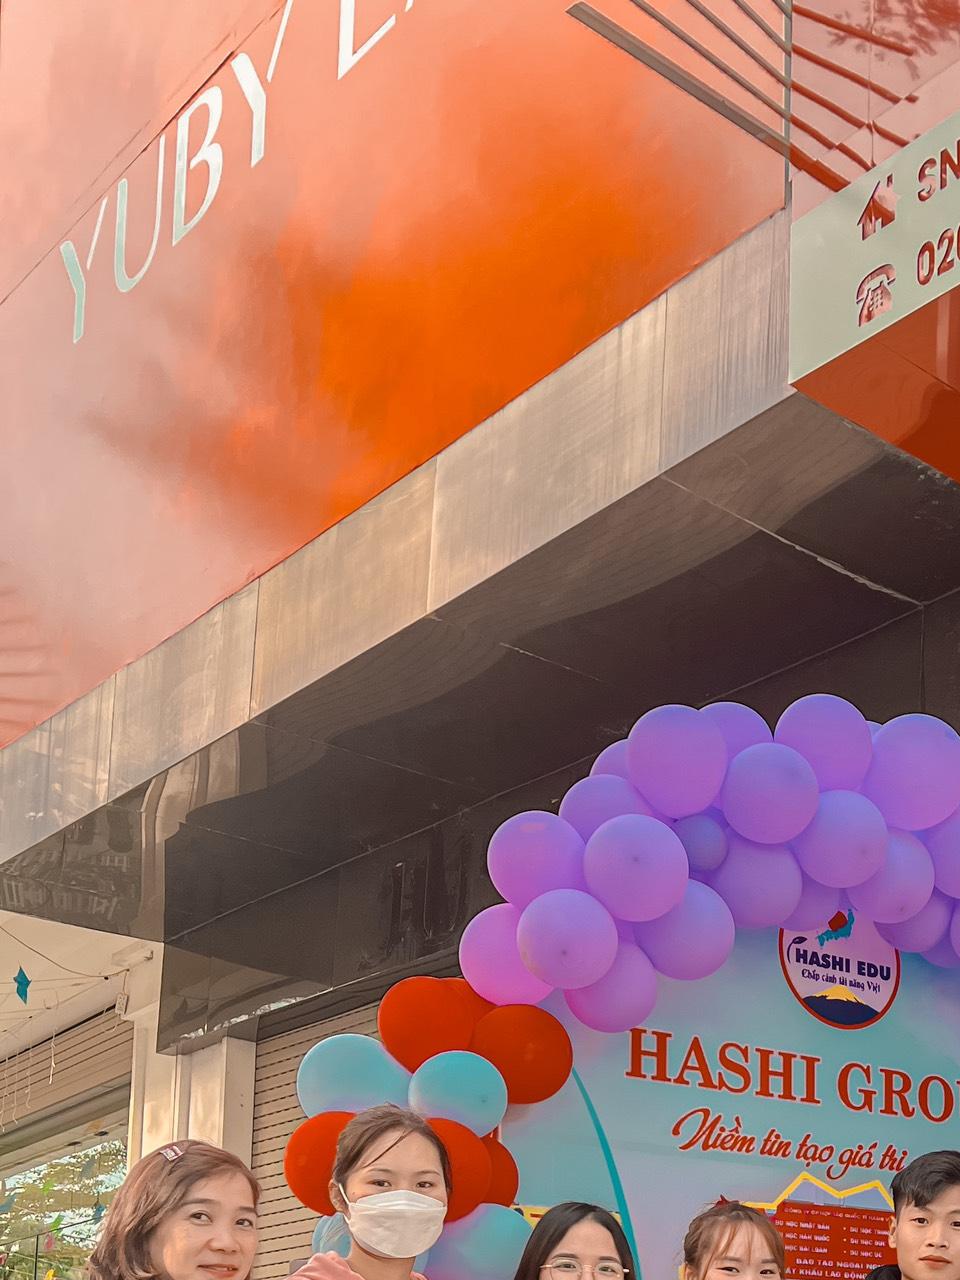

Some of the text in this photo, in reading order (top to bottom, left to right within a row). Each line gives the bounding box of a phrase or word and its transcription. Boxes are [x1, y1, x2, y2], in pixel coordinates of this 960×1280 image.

[60, 0, 294, 343] YUBY
[795, 948, 891, 981] HASHI EDU
[624, 1027, 821, 1105] HASHI
[671, 1108, 755, 1151] Niềm
[760, 1129, 791, 1158] tin
[796, 1133, 834, 1167] tạo
[826, 1142, 878, 1180] giá
